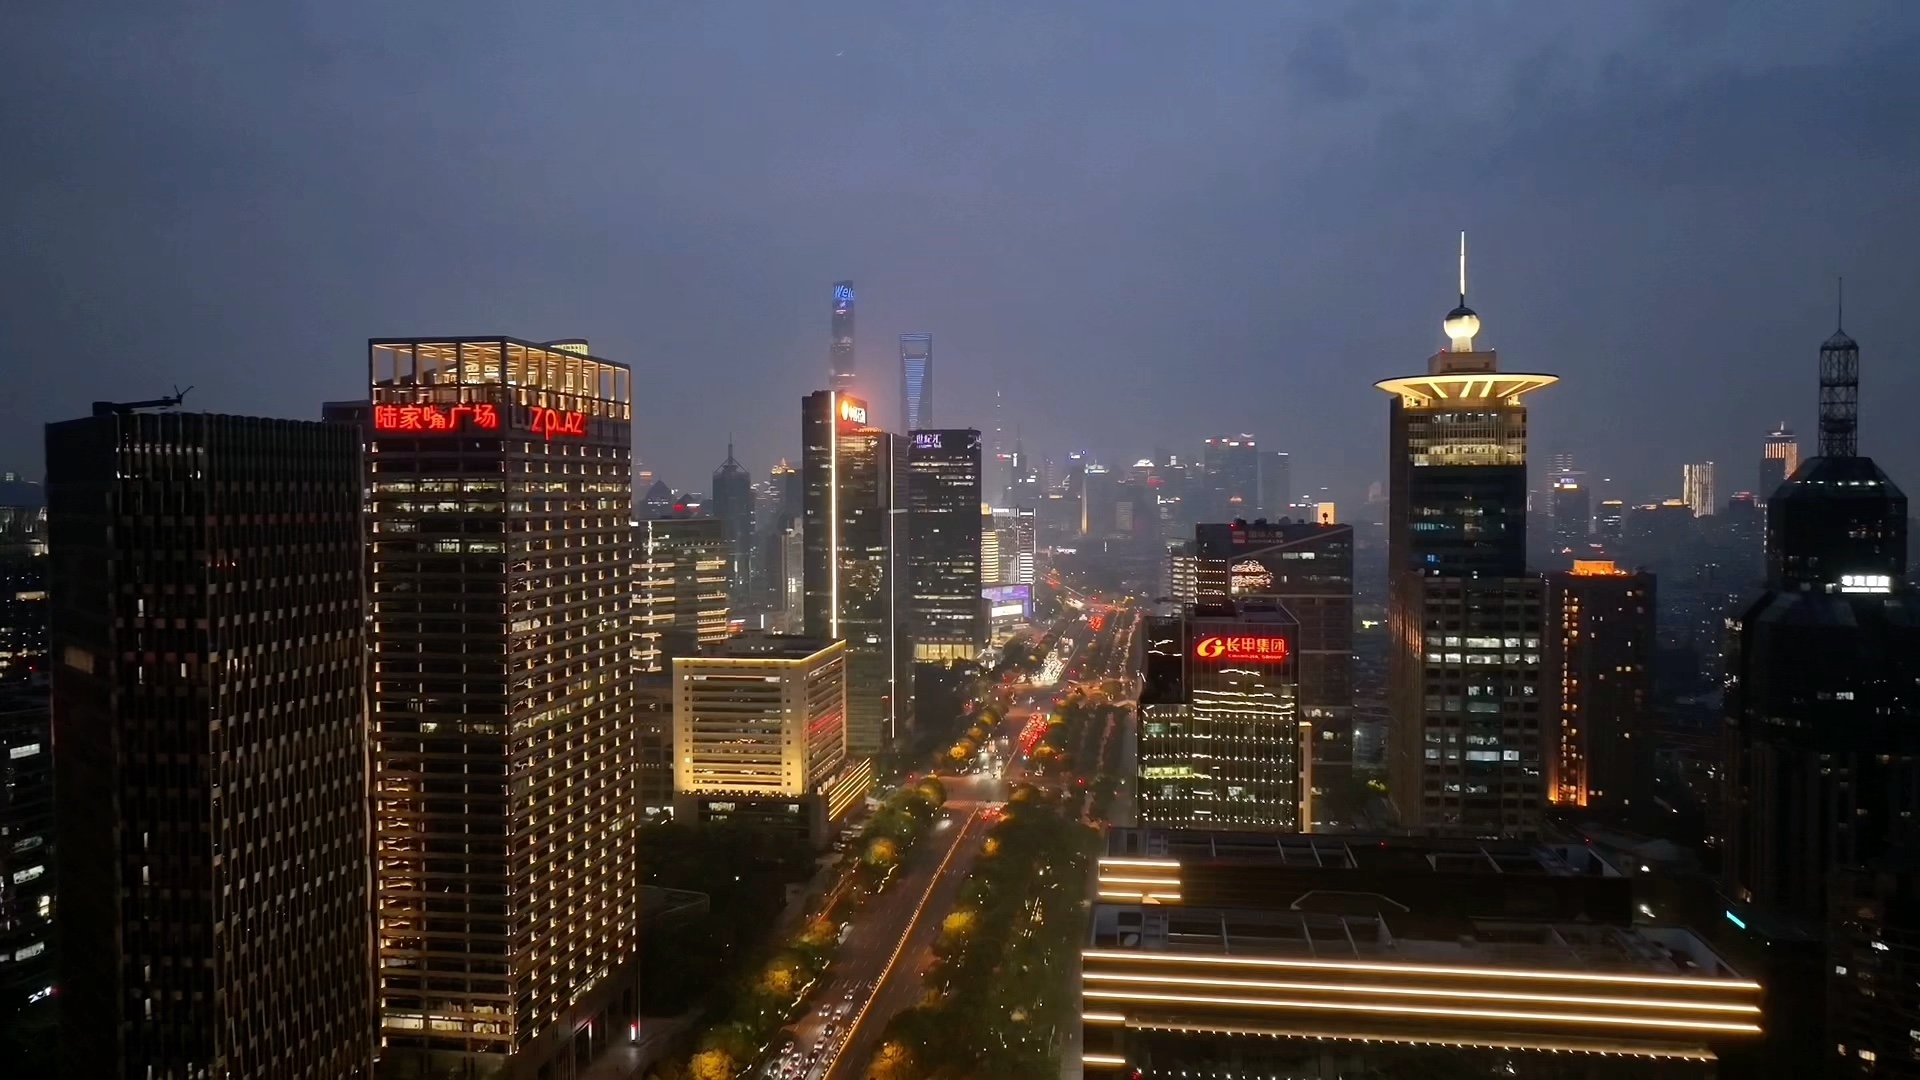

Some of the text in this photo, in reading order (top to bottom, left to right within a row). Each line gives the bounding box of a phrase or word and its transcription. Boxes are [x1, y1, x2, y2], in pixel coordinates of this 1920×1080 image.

[375, 405, 496, 429] 陆家嘴广场
[1226, 637, 1285, 652] 长甲集团
